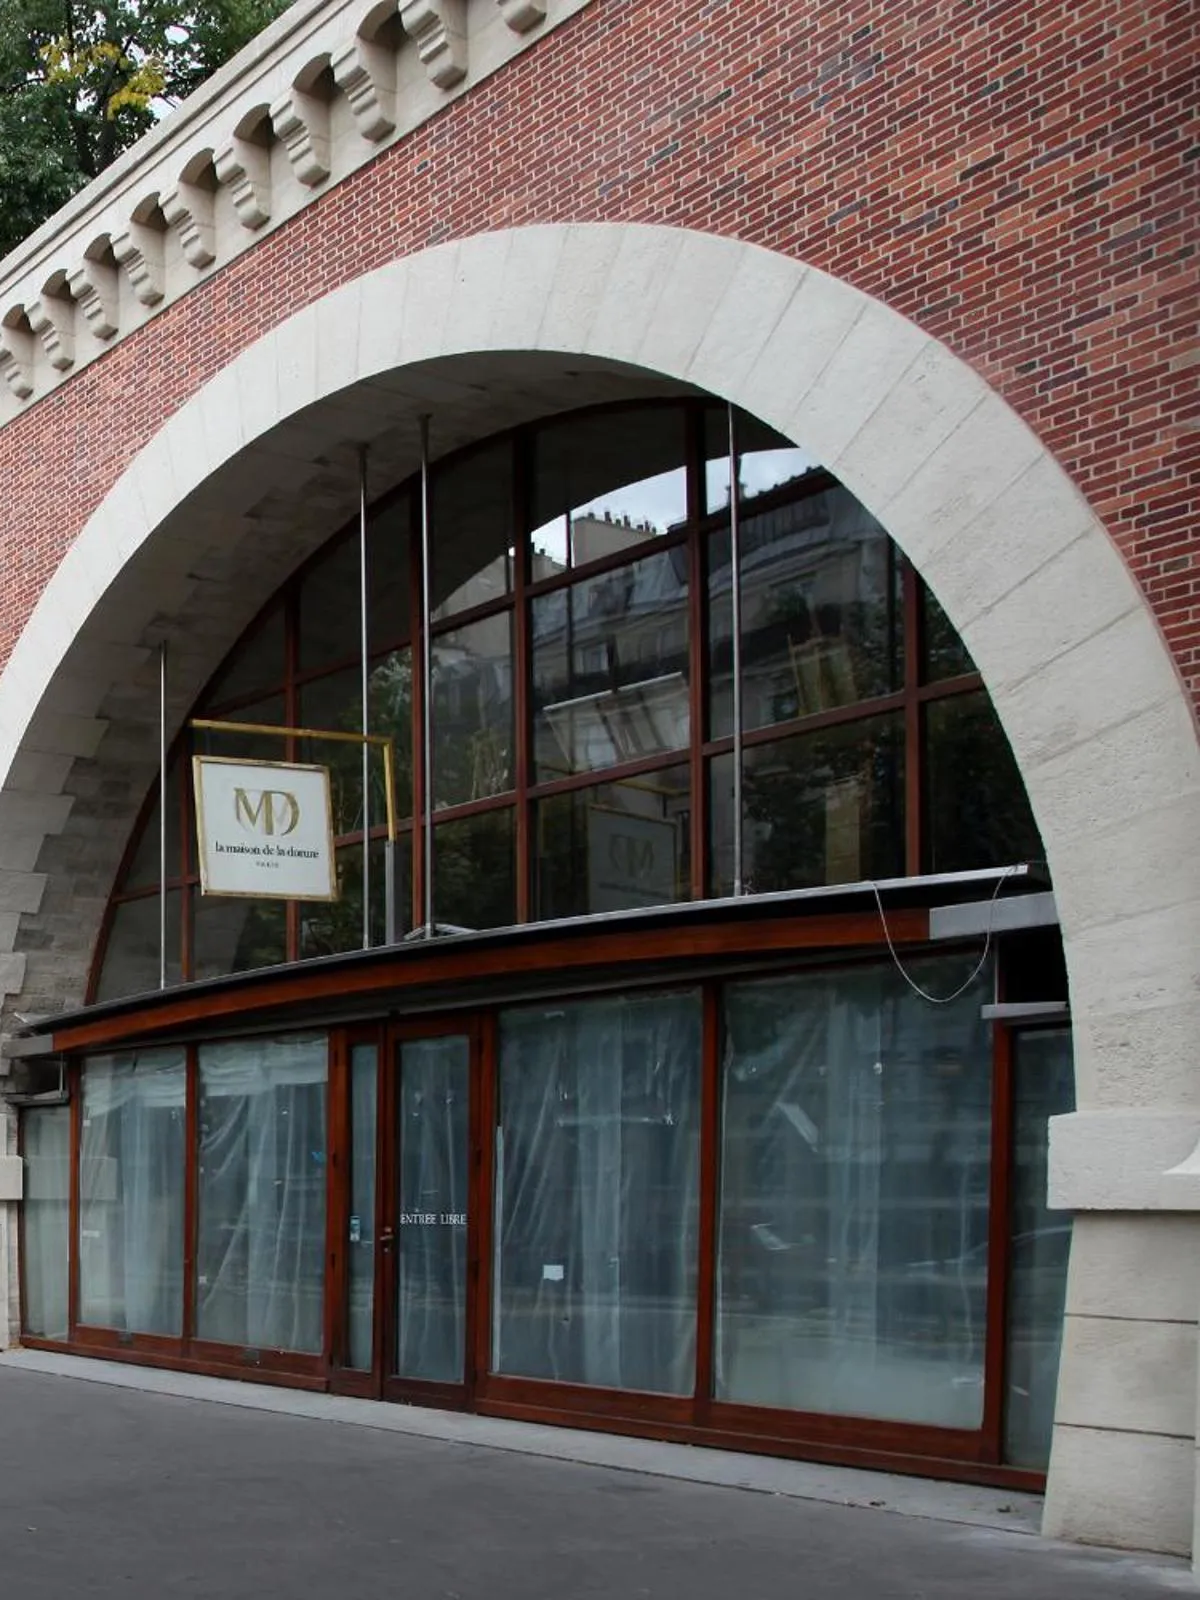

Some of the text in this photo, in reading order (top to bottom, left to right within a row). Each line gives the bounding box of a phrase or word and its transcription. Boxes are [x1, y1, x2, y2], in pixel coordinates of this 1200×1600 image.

[234, 788, 299, 836] MD
[215, 840, 224, 853] la
[226, 844, 260, 855] maison
[262, 844, 274, 856] de
[440, 1213, 468, 1225] LIBRE
